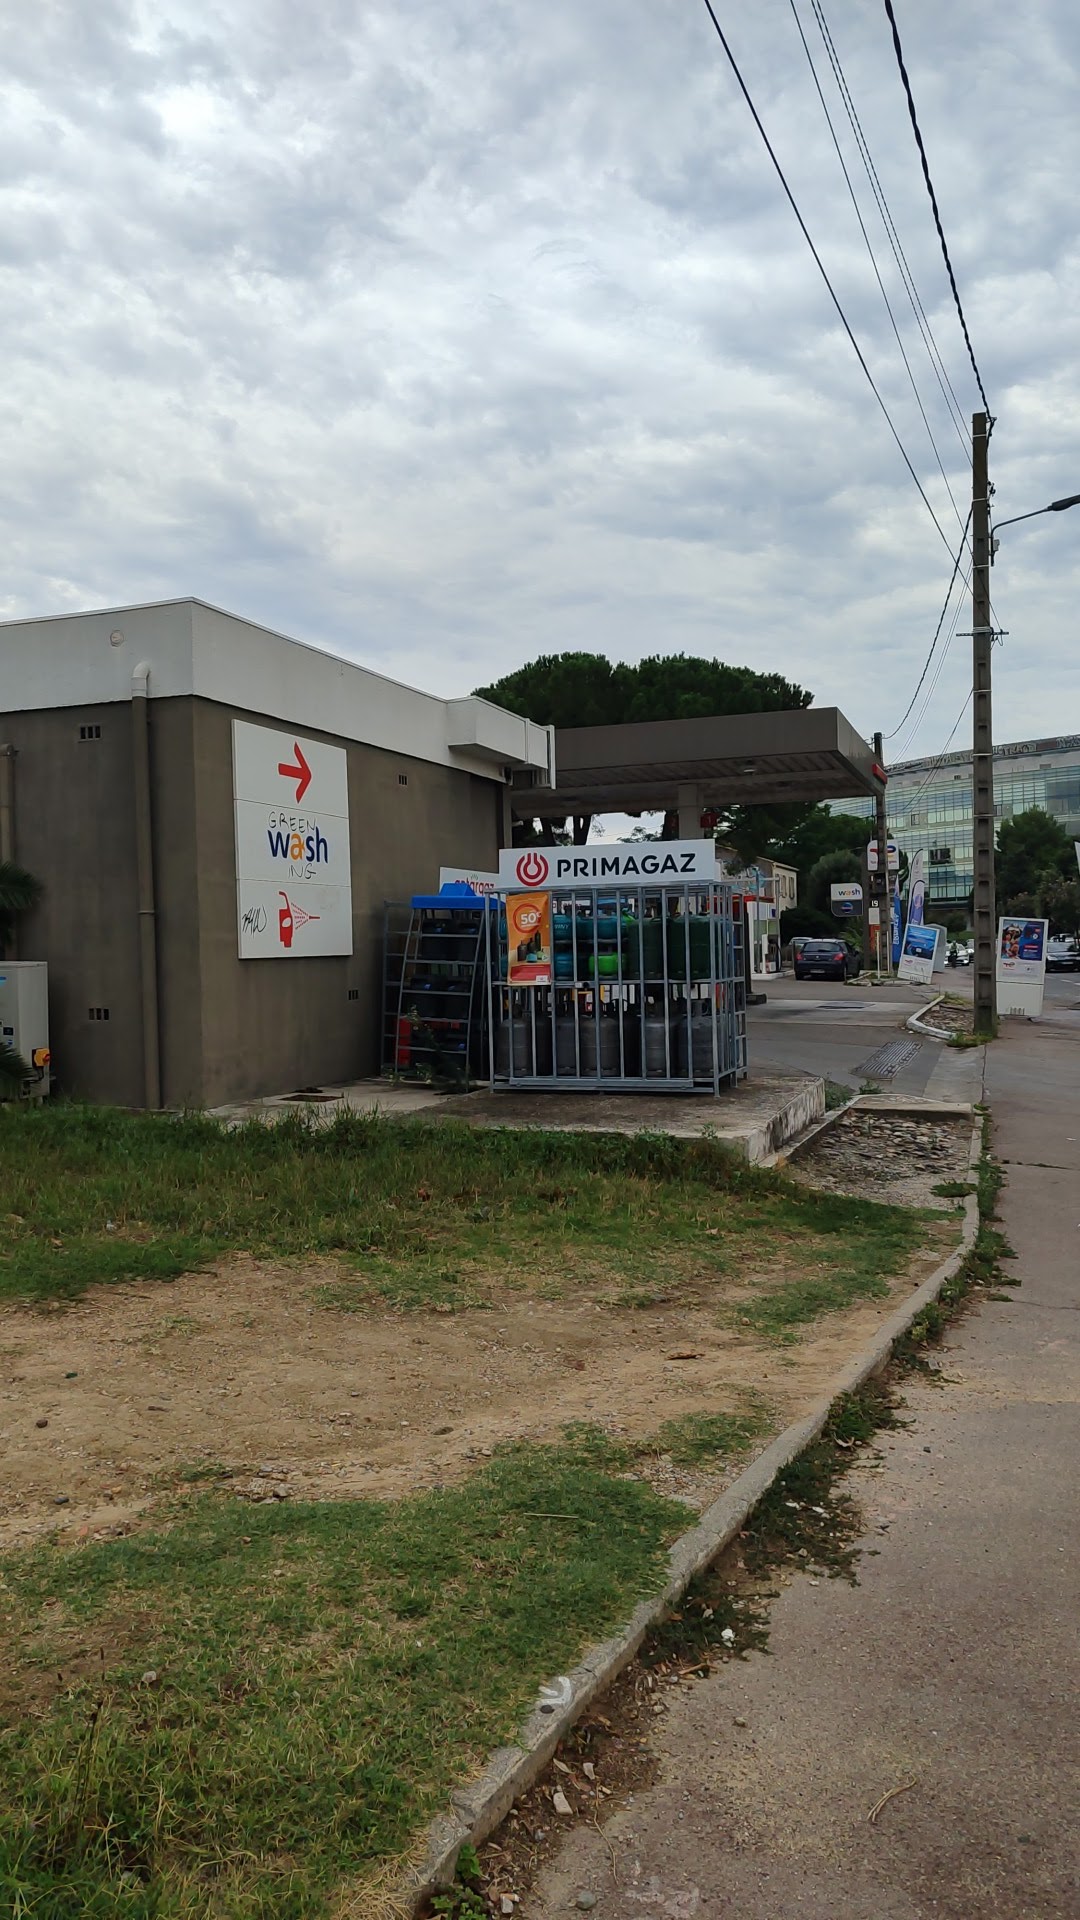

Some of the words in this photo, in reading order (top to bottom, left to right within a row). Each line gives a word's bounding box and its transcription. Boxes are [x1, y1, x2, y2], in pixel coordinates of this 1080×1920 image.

[269, 811, 316, 833] GREEN
[267, 826, 328, 864] wash
[288, 862, 316, 880] ING
[557, 853, 696, 877] PRIMAGAZ
[838, 887, 860, 896] wash
